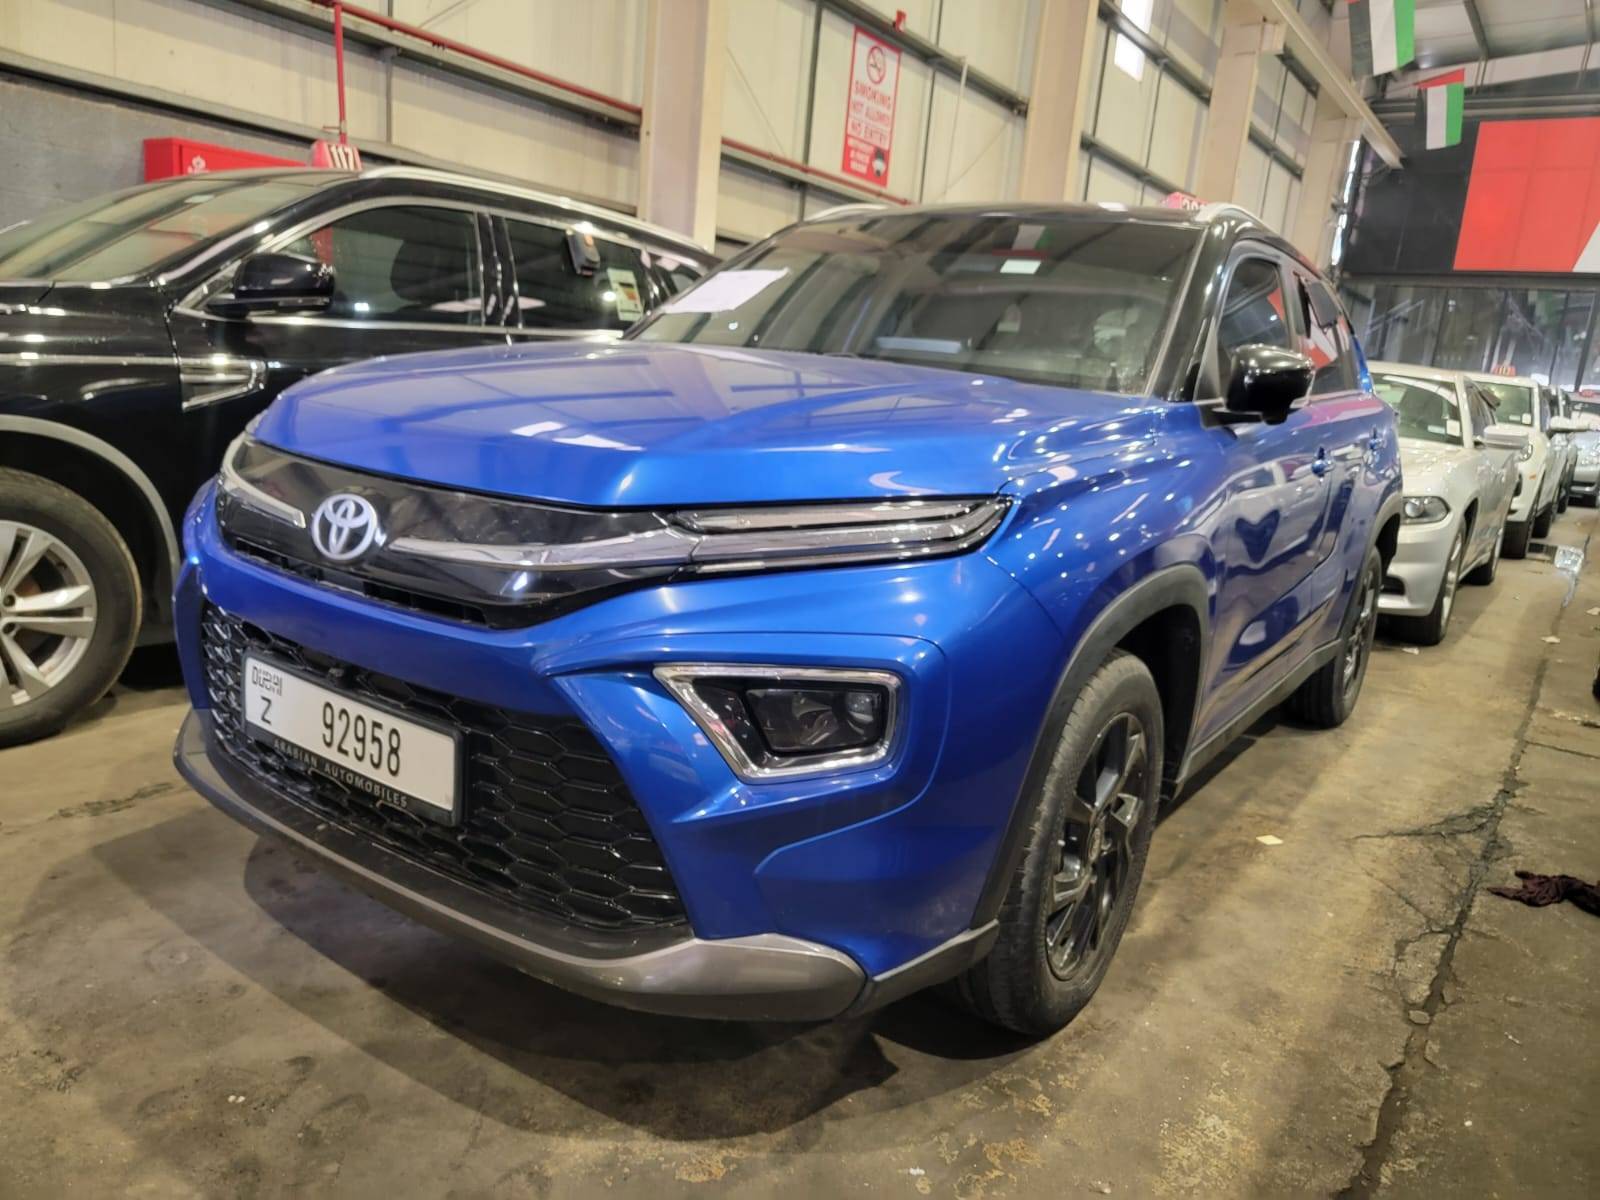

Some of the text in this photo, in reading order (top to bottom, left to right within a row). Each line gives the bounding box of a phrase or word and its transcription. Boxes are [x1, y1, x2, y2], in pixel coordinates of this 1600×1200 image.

[330, 144, 354, 171] 117
[260, 696, 401, 776] Z 92958
[274, 739, 408, 807] ARABIAN AUTOMOBILES
